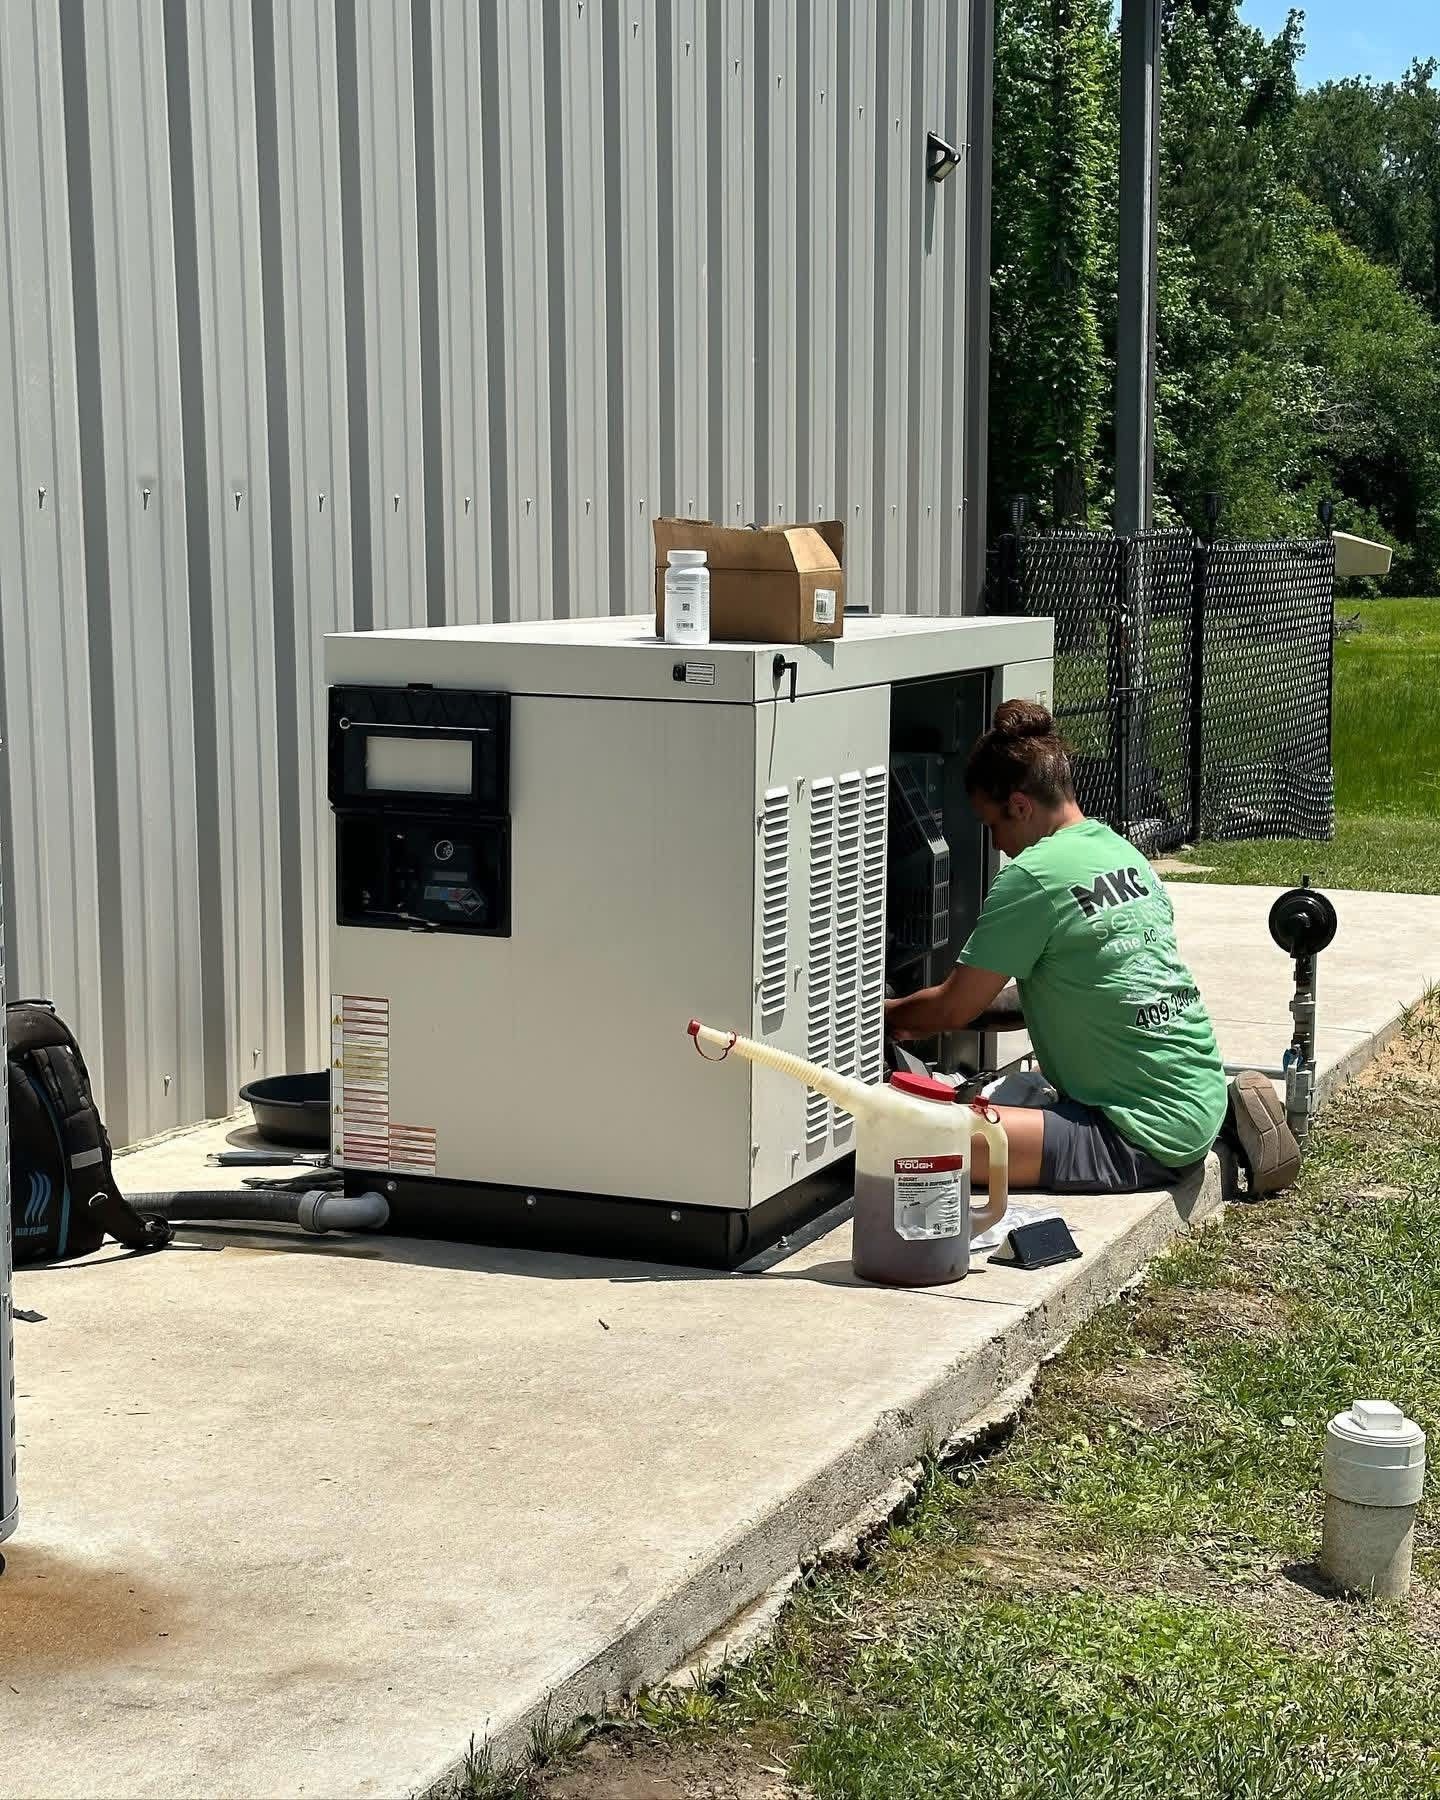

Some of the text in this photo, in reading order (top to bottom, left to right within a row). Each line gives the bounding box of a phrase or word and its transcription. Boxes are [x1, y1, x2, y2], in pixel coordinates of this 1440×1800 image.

[1069, 867, 1150, 918] MKC
[1143, 928, 1157, 944] AC
[897, 1161, 933, 1169] TOUGH
